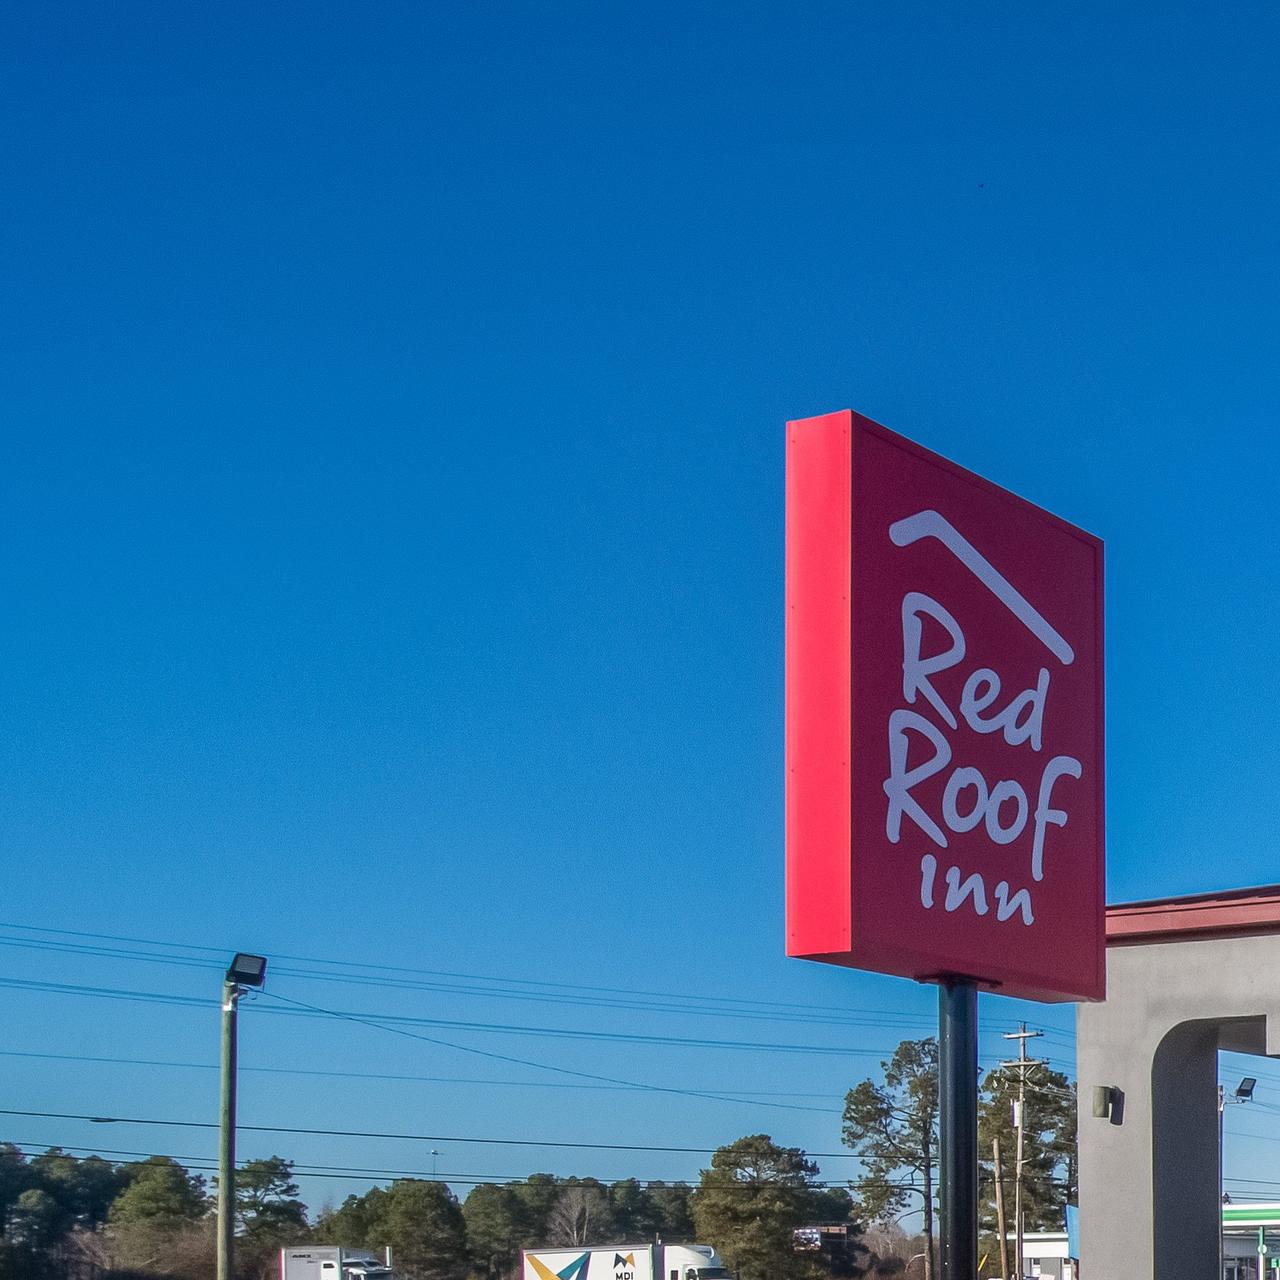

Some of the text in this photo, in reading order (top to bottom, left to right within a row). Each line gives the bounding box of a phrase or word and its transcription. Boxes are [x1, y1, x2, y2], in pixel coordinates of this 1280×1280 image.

[902, 592, 1050, 752] Red
[883, 709, 1082, 881] Roof
[616, 1272, 633, 1280] MDI
